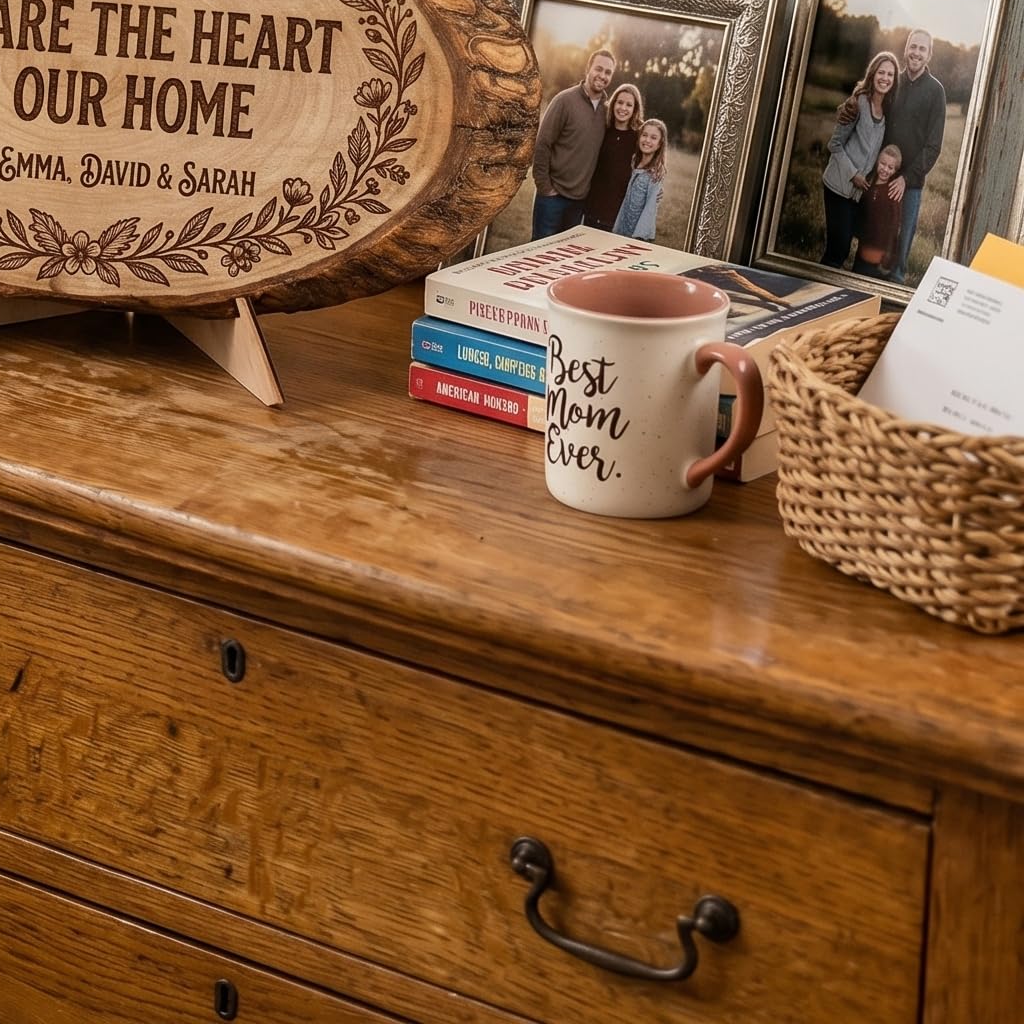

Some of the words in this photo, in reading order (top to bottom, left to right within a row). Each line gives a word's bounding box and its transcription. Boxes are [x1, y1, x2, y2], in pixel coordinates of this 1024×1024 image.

[90, 1, 177, 62] THE
[190, 9, 343, 75] HEART
[13, 66, 108, 128] OUR
[122, 74, 256, 140] HOME
[156, 164, 173, 190] &
[548, 334, 618, 398] Best
[546, 384, 630, 440] Mom
[547, 422, 622, 482] Ever.
